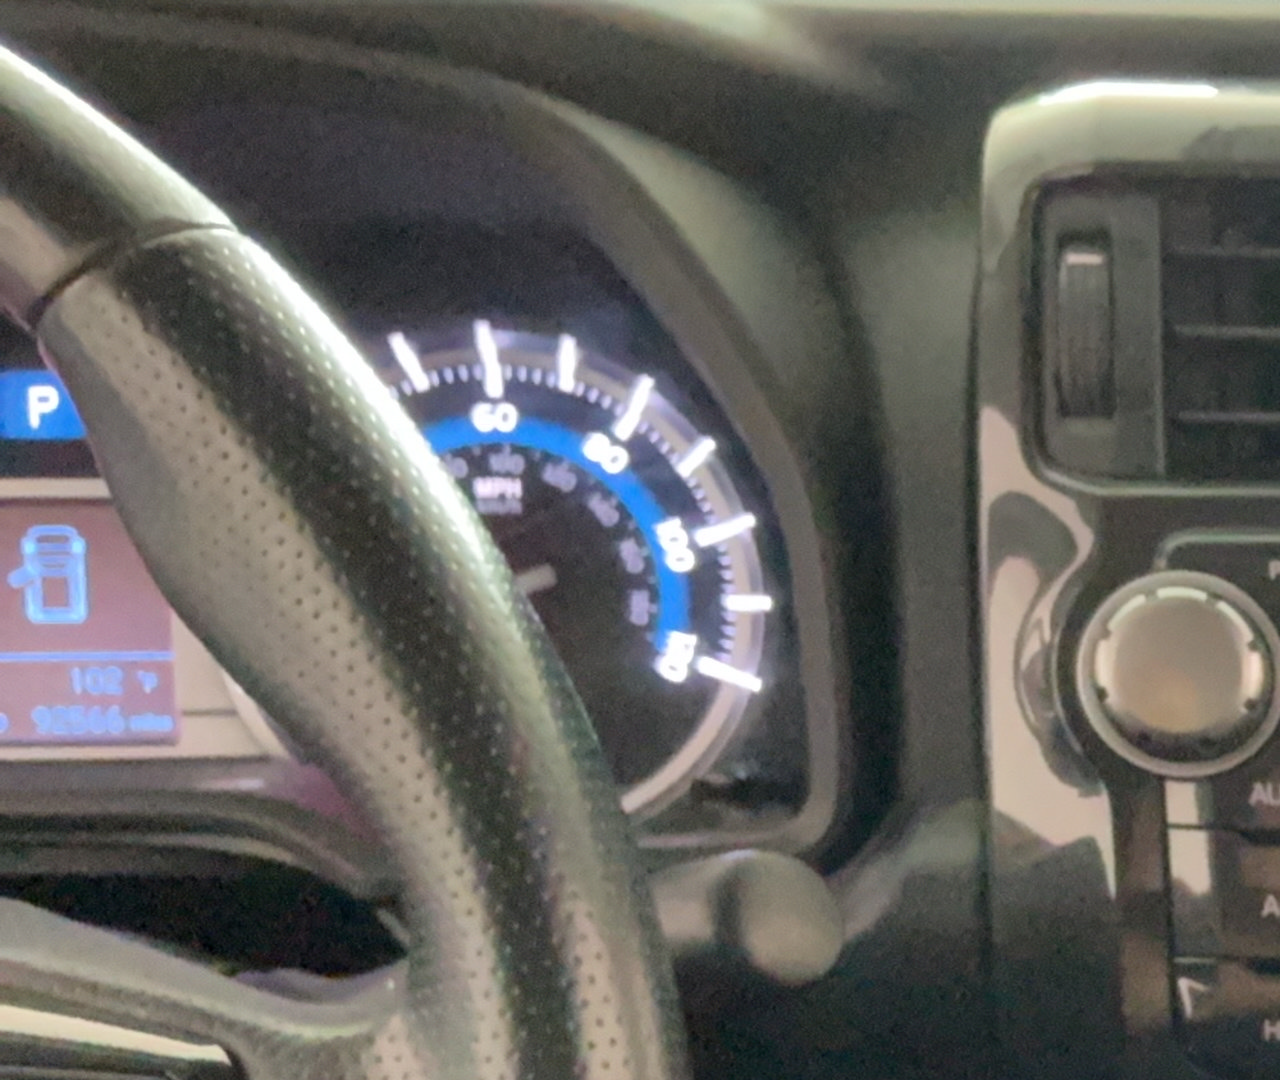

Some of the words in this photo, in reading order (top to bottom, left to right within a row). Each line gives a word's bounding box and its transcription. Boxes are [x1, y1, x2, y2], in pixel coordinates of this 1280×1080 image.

[27, 385, 59, 430] P
[471, 402, 518, 433] 60
[582, 432, 629, 474] 80
[655, 516, 696, 573] 100
[656, 630, 697, 683] 120
[70, 666, 124, 695] 102
